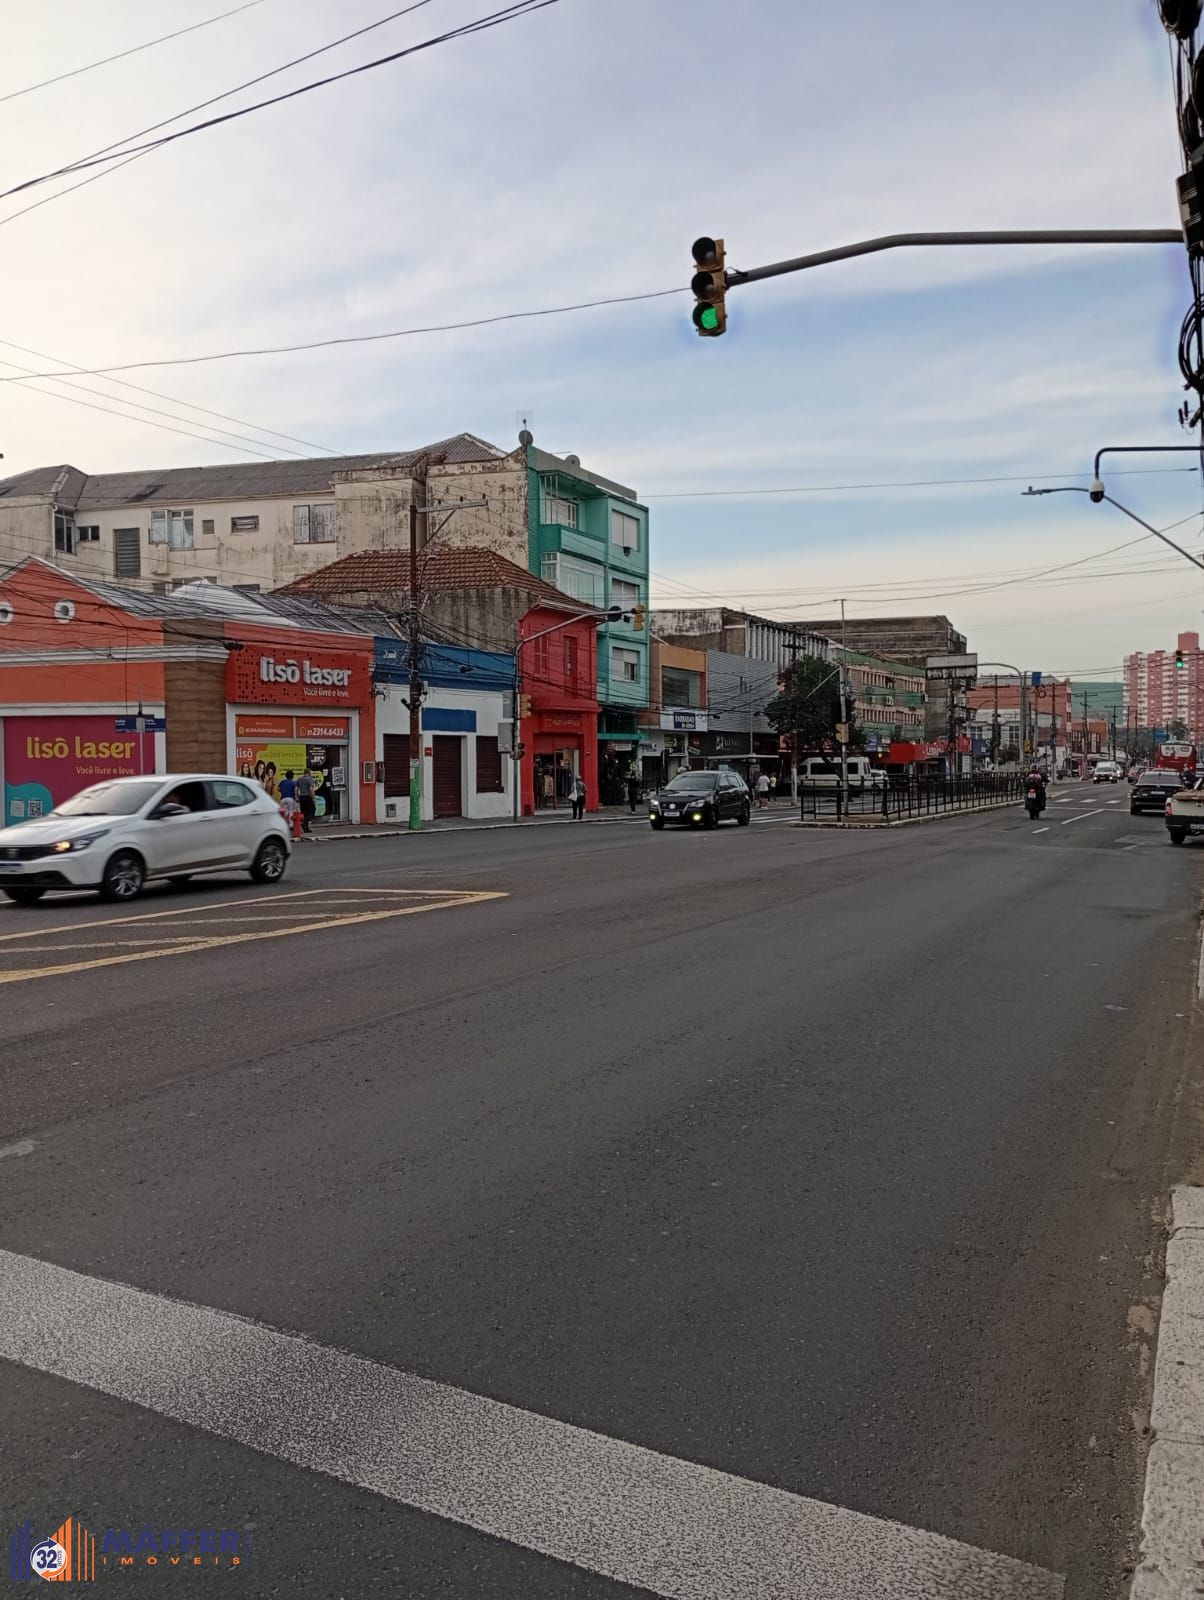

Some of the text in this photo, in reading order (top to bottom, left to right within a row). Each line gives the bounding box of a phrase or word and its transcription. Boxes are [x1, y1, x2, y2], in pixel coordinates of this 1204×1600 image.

[260, 656, 352, 686] lisô laser
[318, 688, 332, 697] livre
[26, 735, 136, 759] lisô laser
[75, 765, 94, 775] Você
[94, 765, 111, 775] livre
